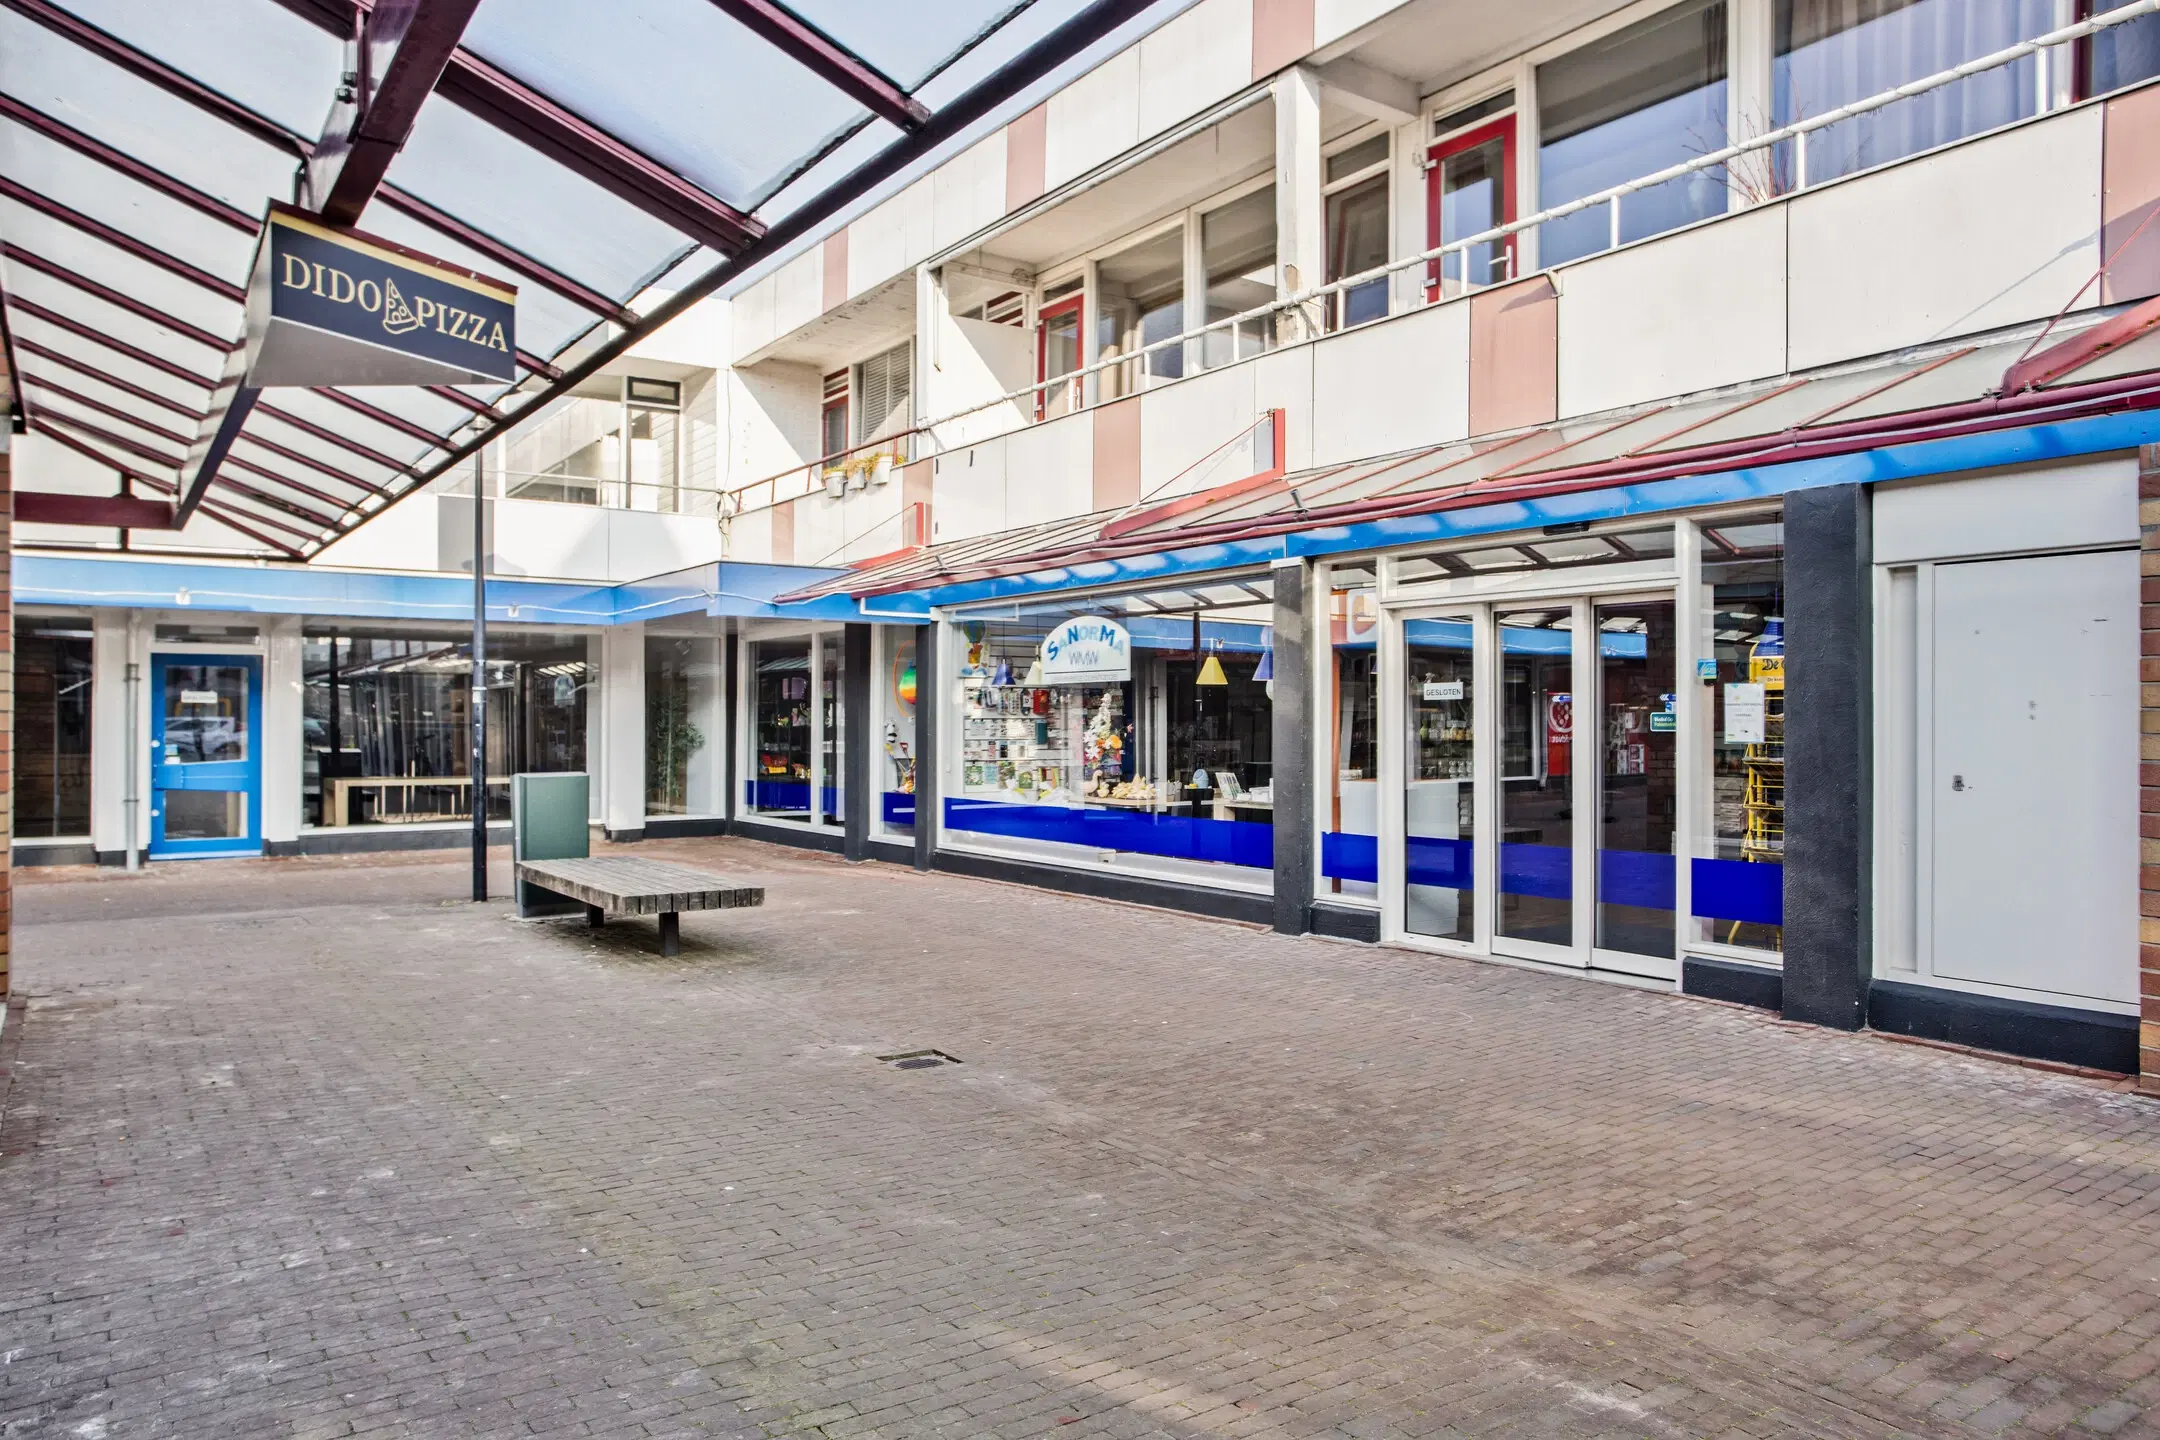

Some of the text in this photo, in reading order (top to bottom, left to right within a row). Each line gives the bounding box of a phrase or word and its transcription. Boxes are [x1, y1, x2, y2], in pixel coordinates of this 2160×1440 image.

[282, 253, 509, 352] DIDO PIZZA
[1762, 658, 1779, 670] De
[1426, 688, 1461, 696] GESLOTEN
